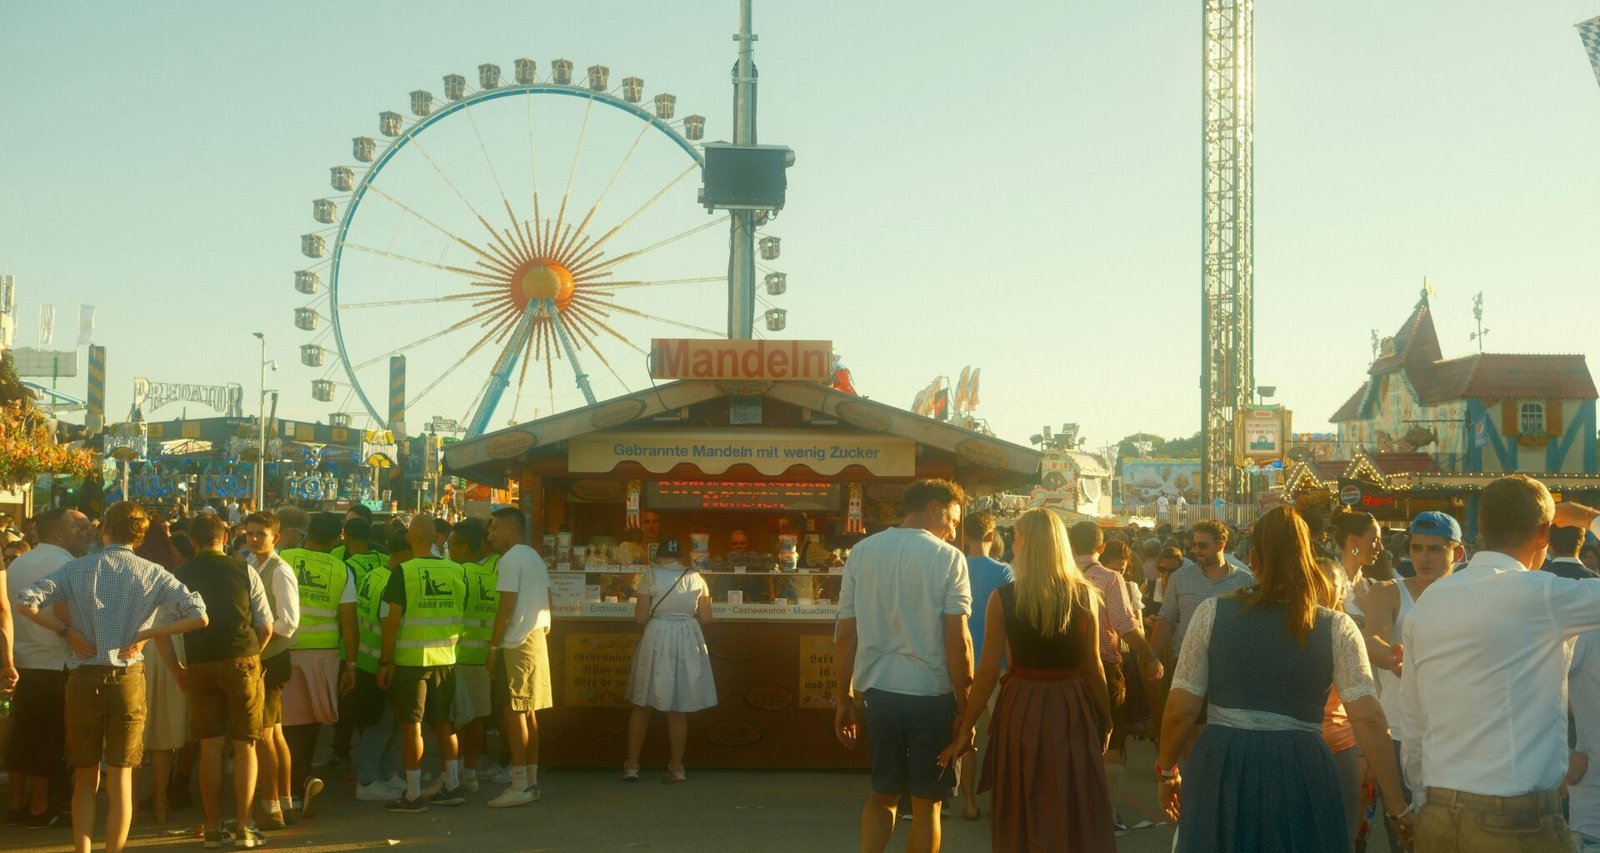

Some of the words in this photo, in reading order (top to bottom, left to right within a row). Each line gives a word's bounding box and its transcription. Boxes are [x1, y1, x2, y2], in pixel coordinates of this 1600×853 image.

[656, 339, 825, 378] Mandeln
[134, 376, 243, 417] PREDATOR
[613, 444, 689, 457] Gebrannte
[692, 445, 753, 457] Mandeln
[757, 446, 779, 458] mit
[783, 446, 826, 460] wenig
[829, 446, 880, 459] Zucker
[590, 604, 628, 613] Erdnüsse
[732, 606, 786, 615] Cashewkerne
